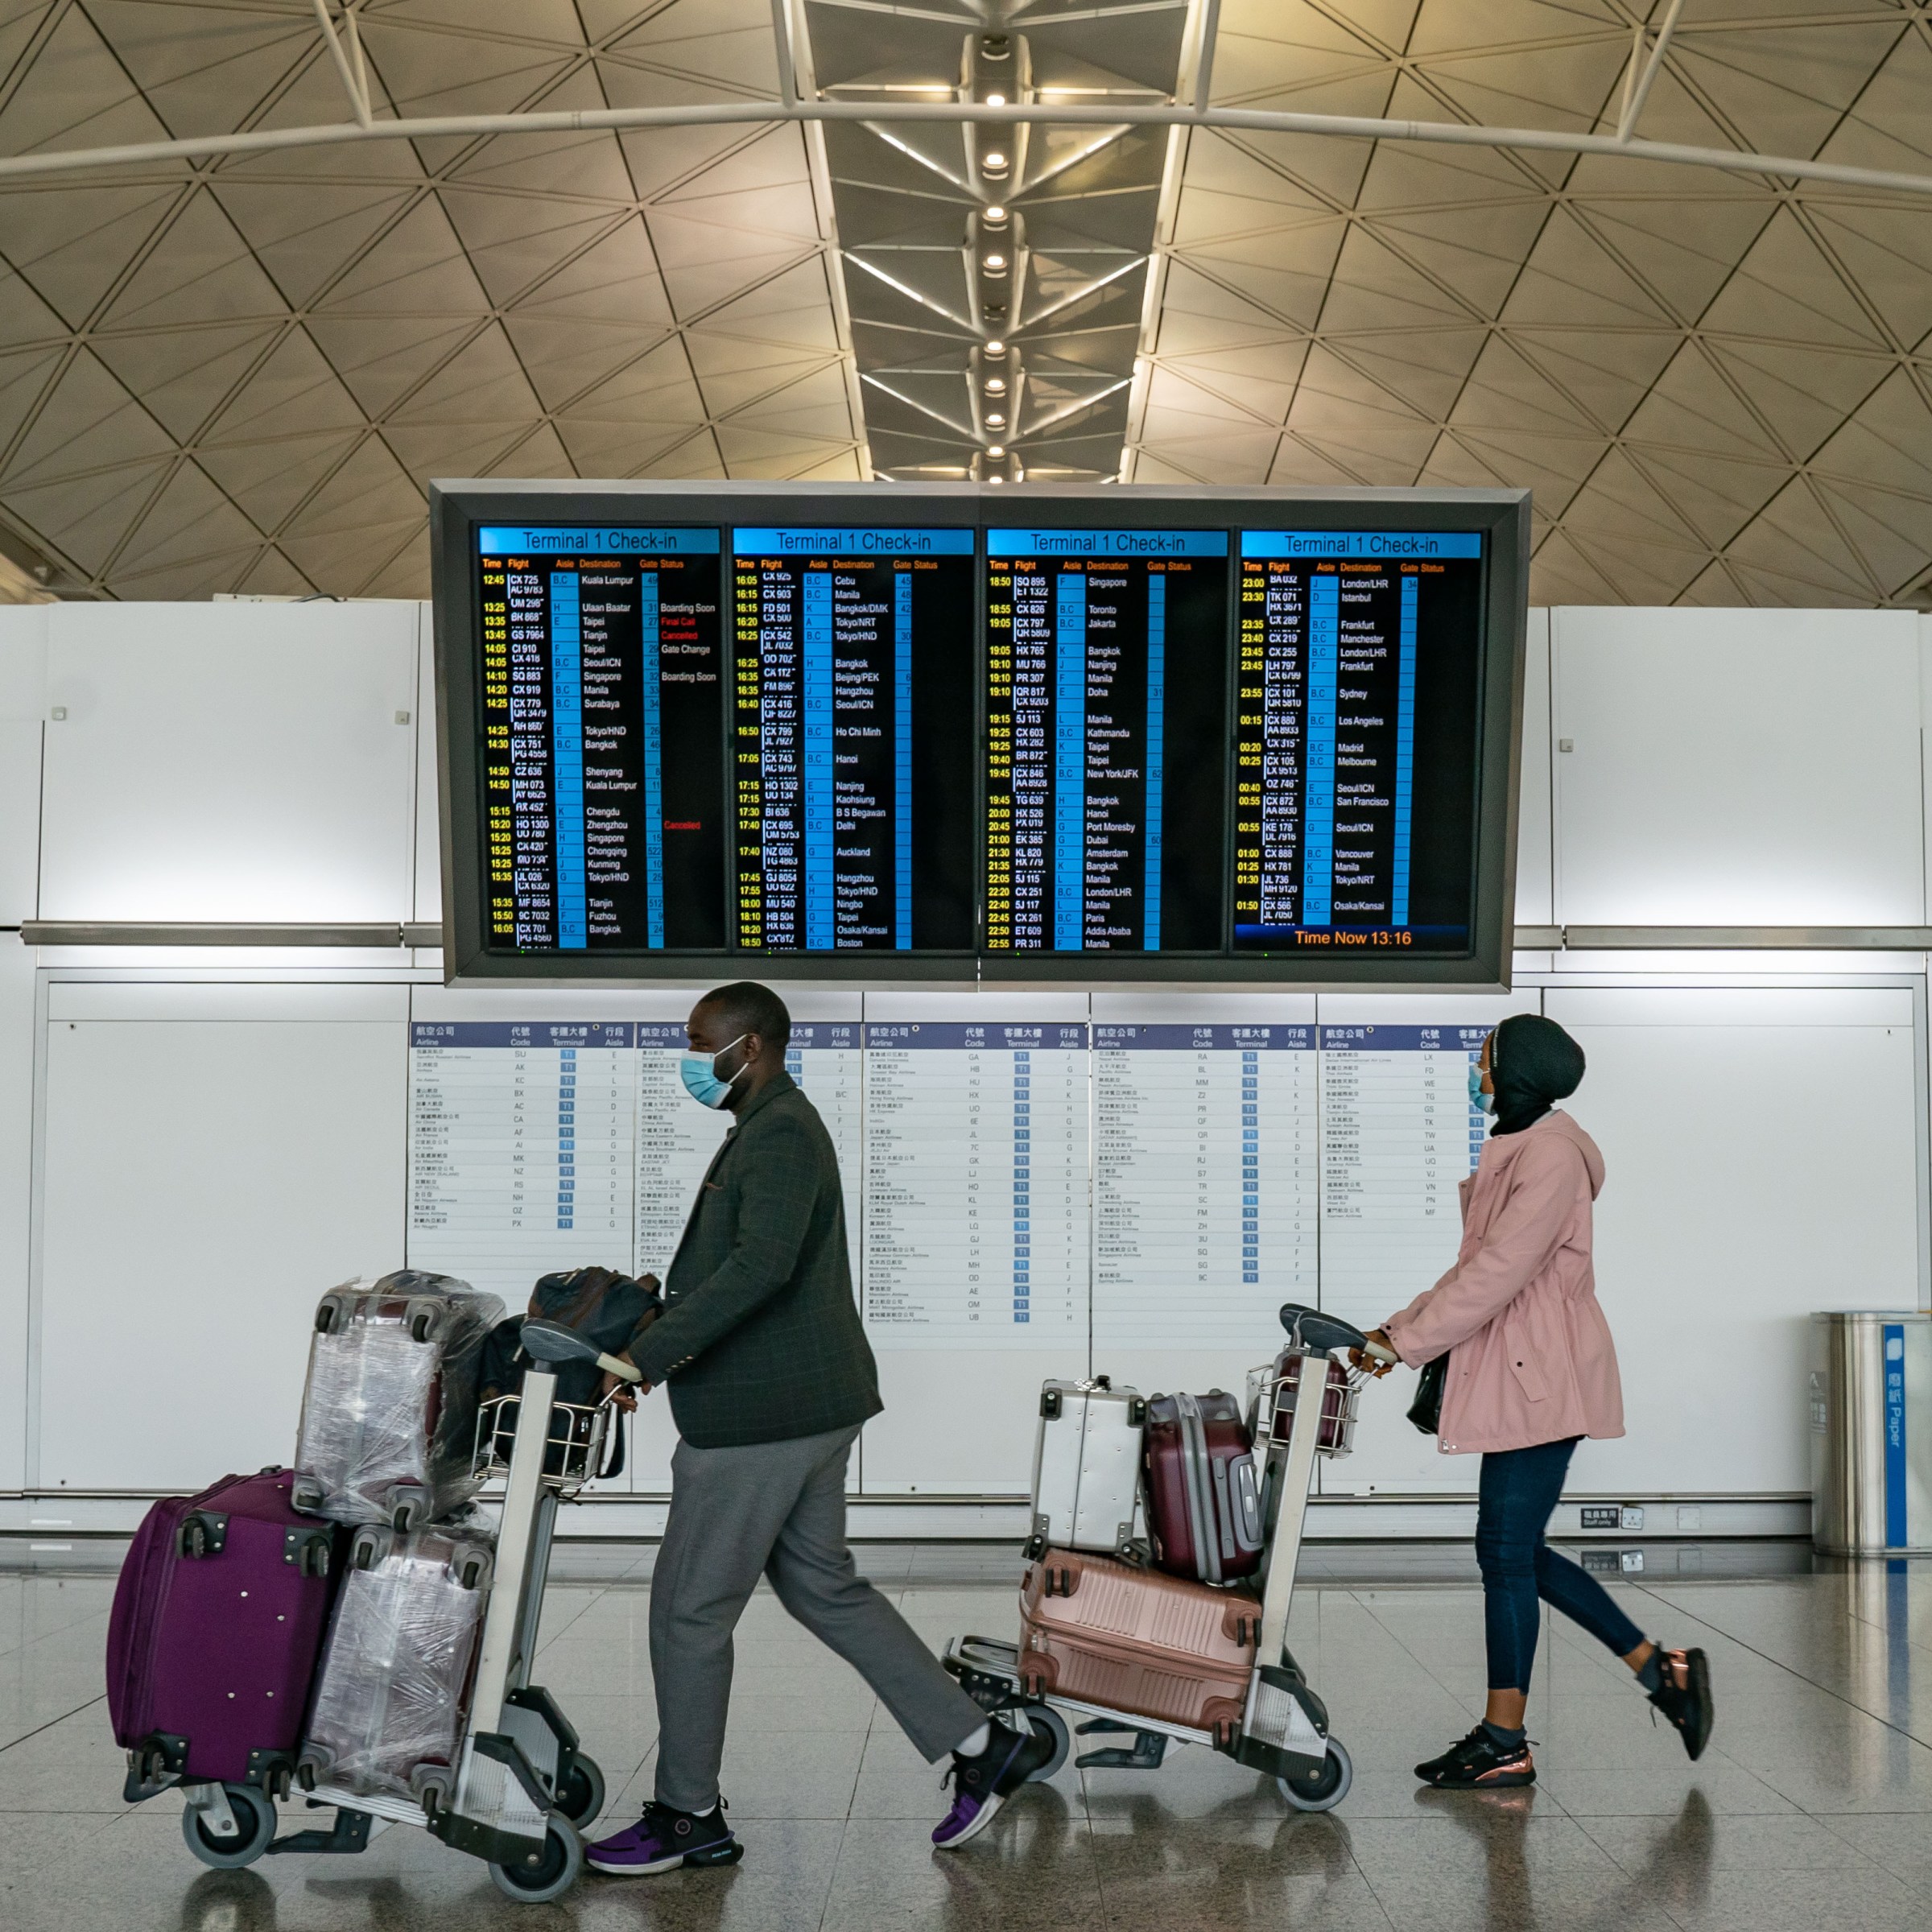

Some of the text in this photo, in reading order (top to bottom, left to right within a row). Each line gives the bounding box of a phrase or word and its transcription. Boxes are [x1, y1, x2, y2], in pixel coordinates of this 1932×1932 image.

[523, 532, 677, 549] Terminal 1 Check-in
[777, 533, 931, 549] Terminal 1 Check-in
[1031, 534, 1185, 551] Terminal 1 Check-in
[1285, 535, 1439, 553] Terminal 1 Check-in
[736, 560, 938, 570] Time Flight Aisle Destination Gate Status
[1244, 563, 1444, 572] Time Flight Aisle Destination Gate Status
[484, 575, 634, 586] 12:45 CX 725 Kuala Lumpur
[737, 590, 860, 599] 16:15 CX 903 Manila
[1243, 592, 1371, 602] 23:30 TK 071 Istanbul
[485, 603, 506, 612] 13:25
[583, 604, 605, 612] Ulaan
[606, 604, 631, 612] Baatar
[661, 604, 694, 613] Boarding
[696, 604, 715, 613] Soon
[737, 604, 888, 614] 16:15 FD 501 Bangkok/DMK
[990, 605, 1117, 614] 18:55 CX 826 Toronto
[990, 619, 1116, 628] 19:05 Jakarta
[1241, 662, 1374, 671] 23:45 LH 797 Frankfurt
[486, 686, 609, 695] 14:20 CX 919 Manila
[1241, 688, 1368, 700] 23:55 CX 101 Sydney
[738, 727, 881, 736] 16:50 Ho Chi Minh
[1240, 743, 1364, 752] 00:20 Madrid
[739, 782, 865, 792] 17:15 HO 1302 Nanjing
[989, 809, 1109, 818] 20:00 HX 526 Hanoi
[739, 821, 856, 830] 17:40 Delhi
[989, 836, 1108, 844] 21:00 EK 385 Dubai
[1237, 862, 1360, 871] 01:25 HX 781 Manila
[989, 888, 1132, 897] 22:20 CX 251 London/LHR
[493, 911, 617, 921] 15:50 9C 7032 Fuzhou
[1295, 931, 1412, 944] Time Now 13:16
[832, 1039, 850, 1047] Aisle
[965, 1039, 985, 1047] Code
[1889, 1406, 1901, 1447] Paper
